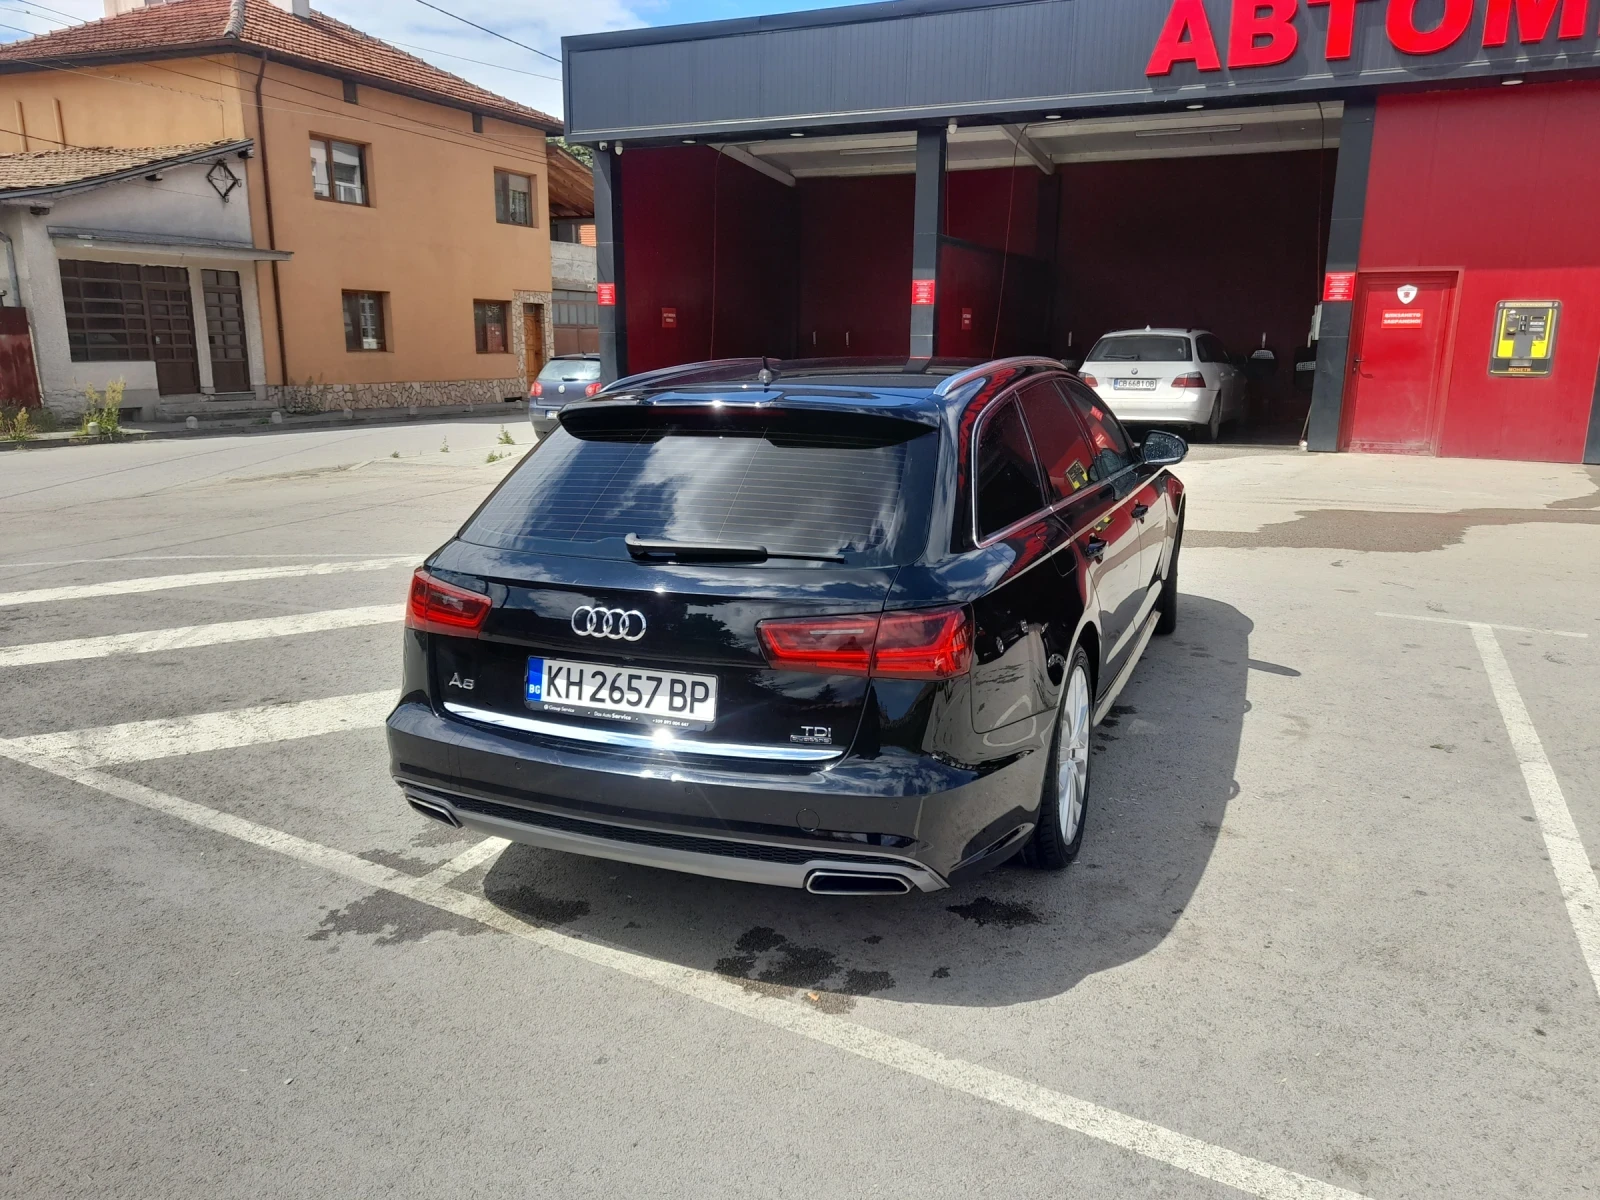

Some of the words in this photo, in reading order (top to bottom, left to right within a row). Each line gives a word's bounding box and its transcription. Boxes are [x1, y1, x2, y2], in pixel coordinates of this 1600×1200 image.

[1145, 0, 1600, 76] АВТОМ
[448, 672, 475, 690] A6
[528, 684, 541, 695] BG
[547, 665, 584, 700] KH
[590, 671, 663, 709] 2657
[668, 678, 710, 714] BP
[800, 725, 832, 738] TDI
